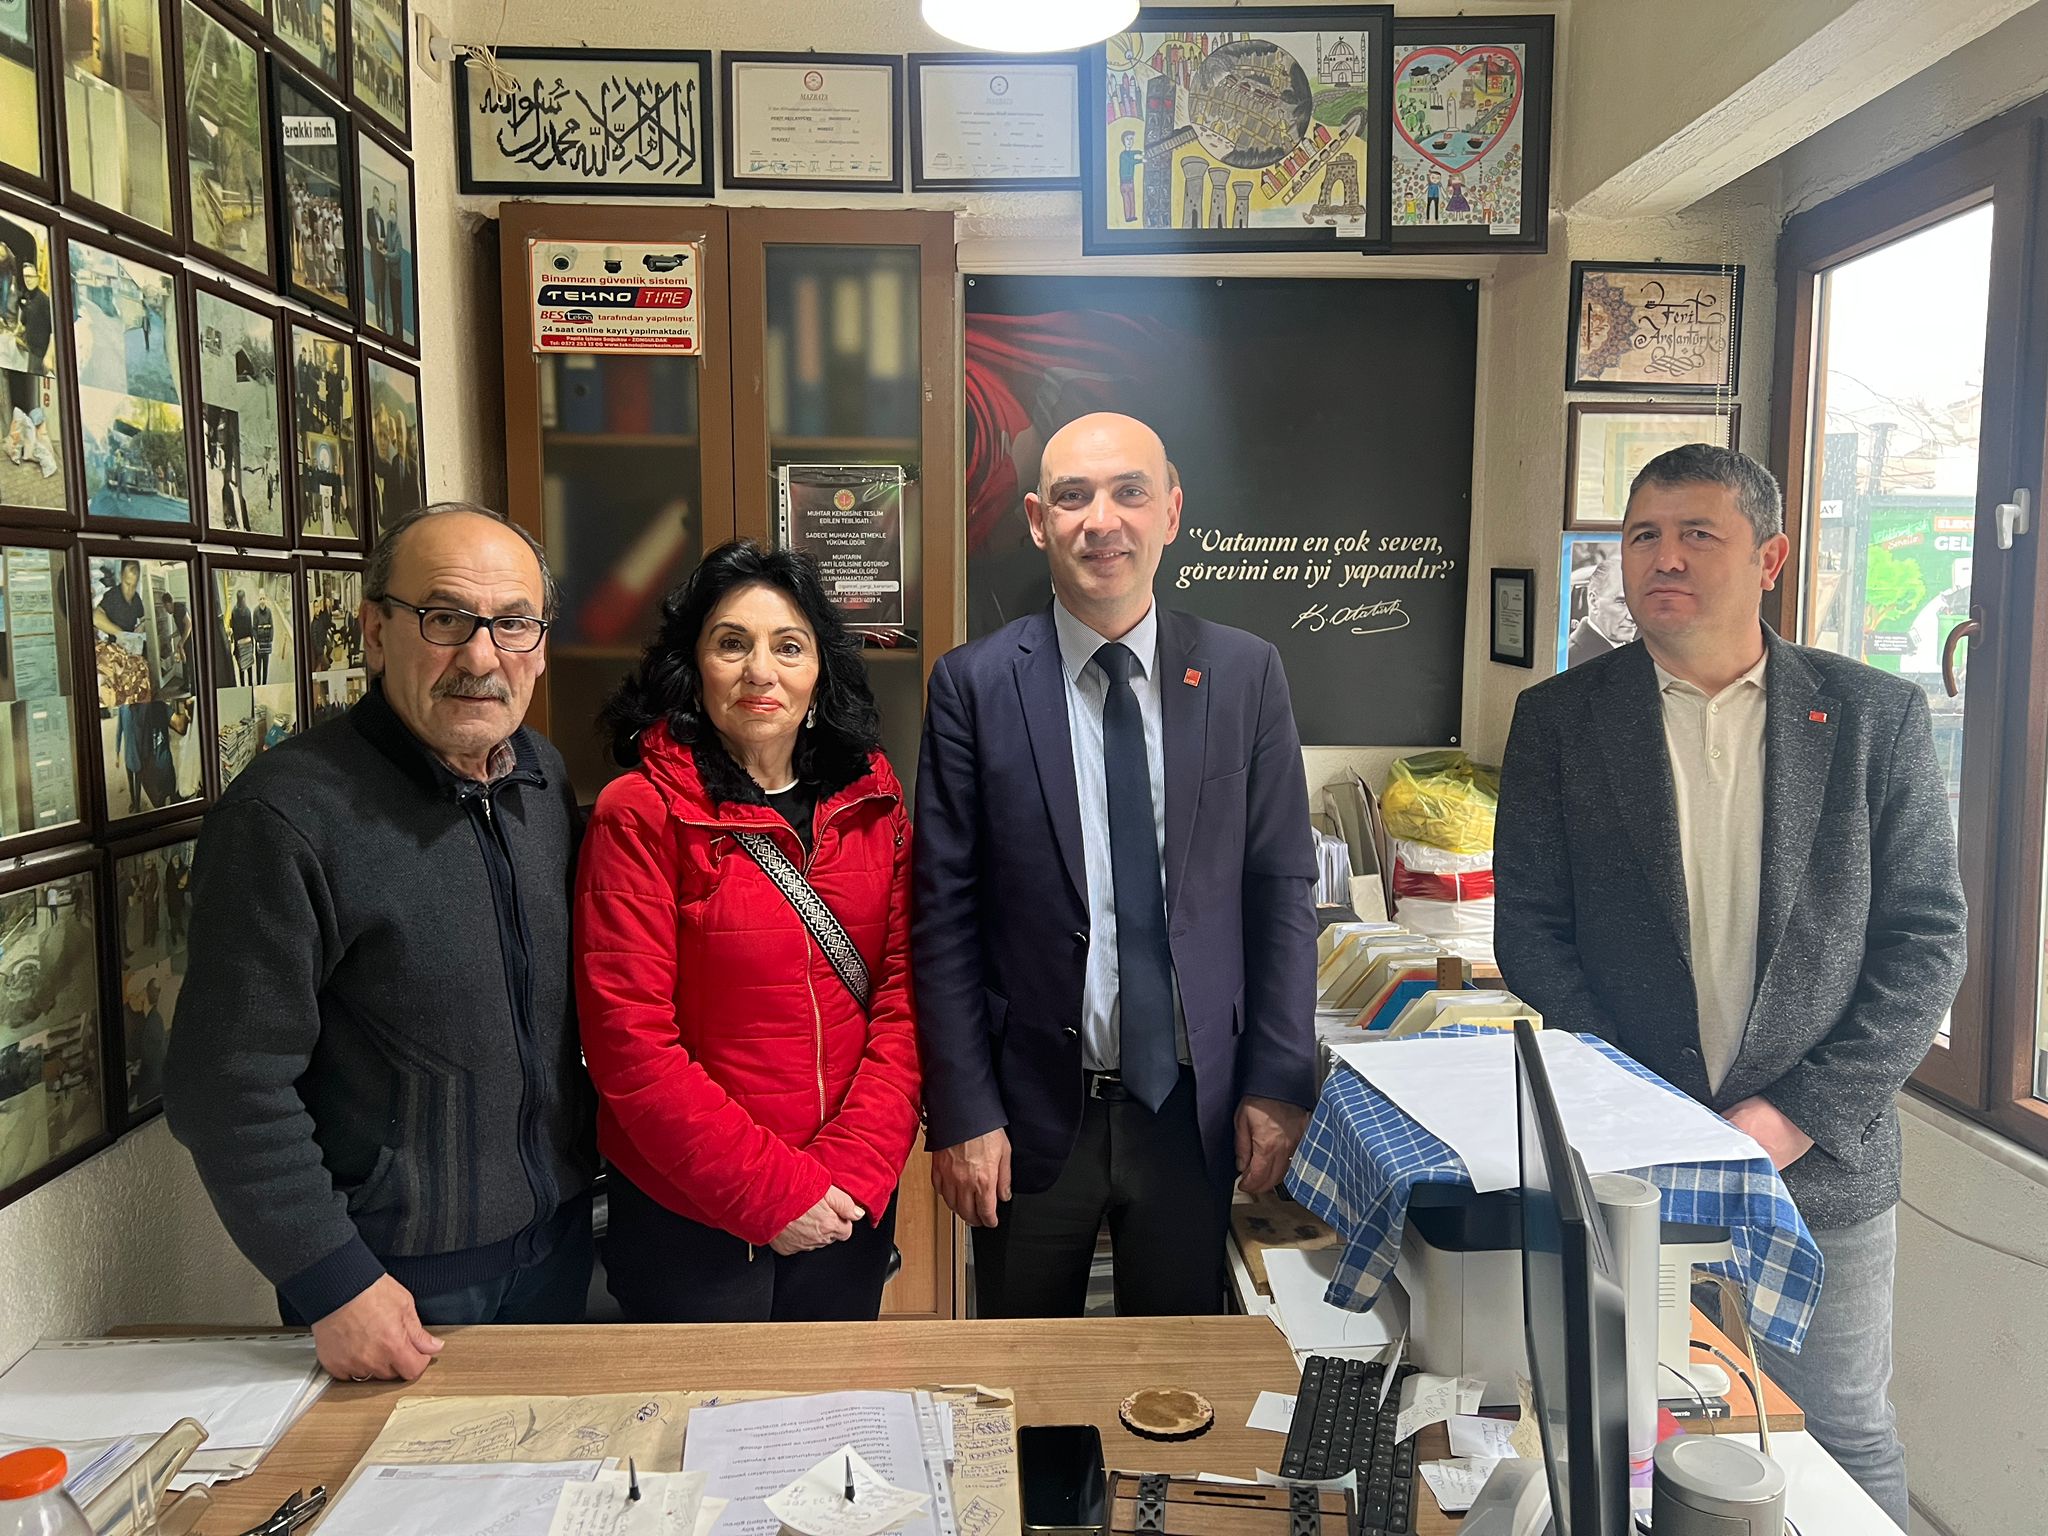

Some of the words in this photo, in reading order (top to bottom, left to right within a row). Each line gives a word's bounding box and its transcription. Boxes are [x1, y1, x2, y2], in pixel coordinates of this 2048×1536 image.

[282, 121, 312, 138] erakki
[313, 121, 335, 138] mah.
[541, 275, 596, 285] Binamızın
[600, 276, 646, 286] güvenlik
[649, 276, 688, 286] sistemi
[547, 291, 632, 302] TEKNO
[645, 291, 685, 305] TIME
[598, 314, 644, 322] tarafından
[646, 314, 694, 324] yapılmıştır.
[577, 326, 604, 334] online
[606, 327, 628, 336] kayıt
[630, 328, 691, 336] yapılmaktadır.
[1820, 505, 1837, 514] AY
[1303, 536, 1329, 552] en
[1334, 529, 1370, 555] çok
[1378, 536, 1443, 555] seven,
[1934, 535, 1973, 552] GEL
[862, 560, 889, 568] GÖTÜRÜP
[1176, 558, 1269, 589] görevini
[1272, 563, 1299, 580] en
[1304, 558, 1333, 589] iyi
